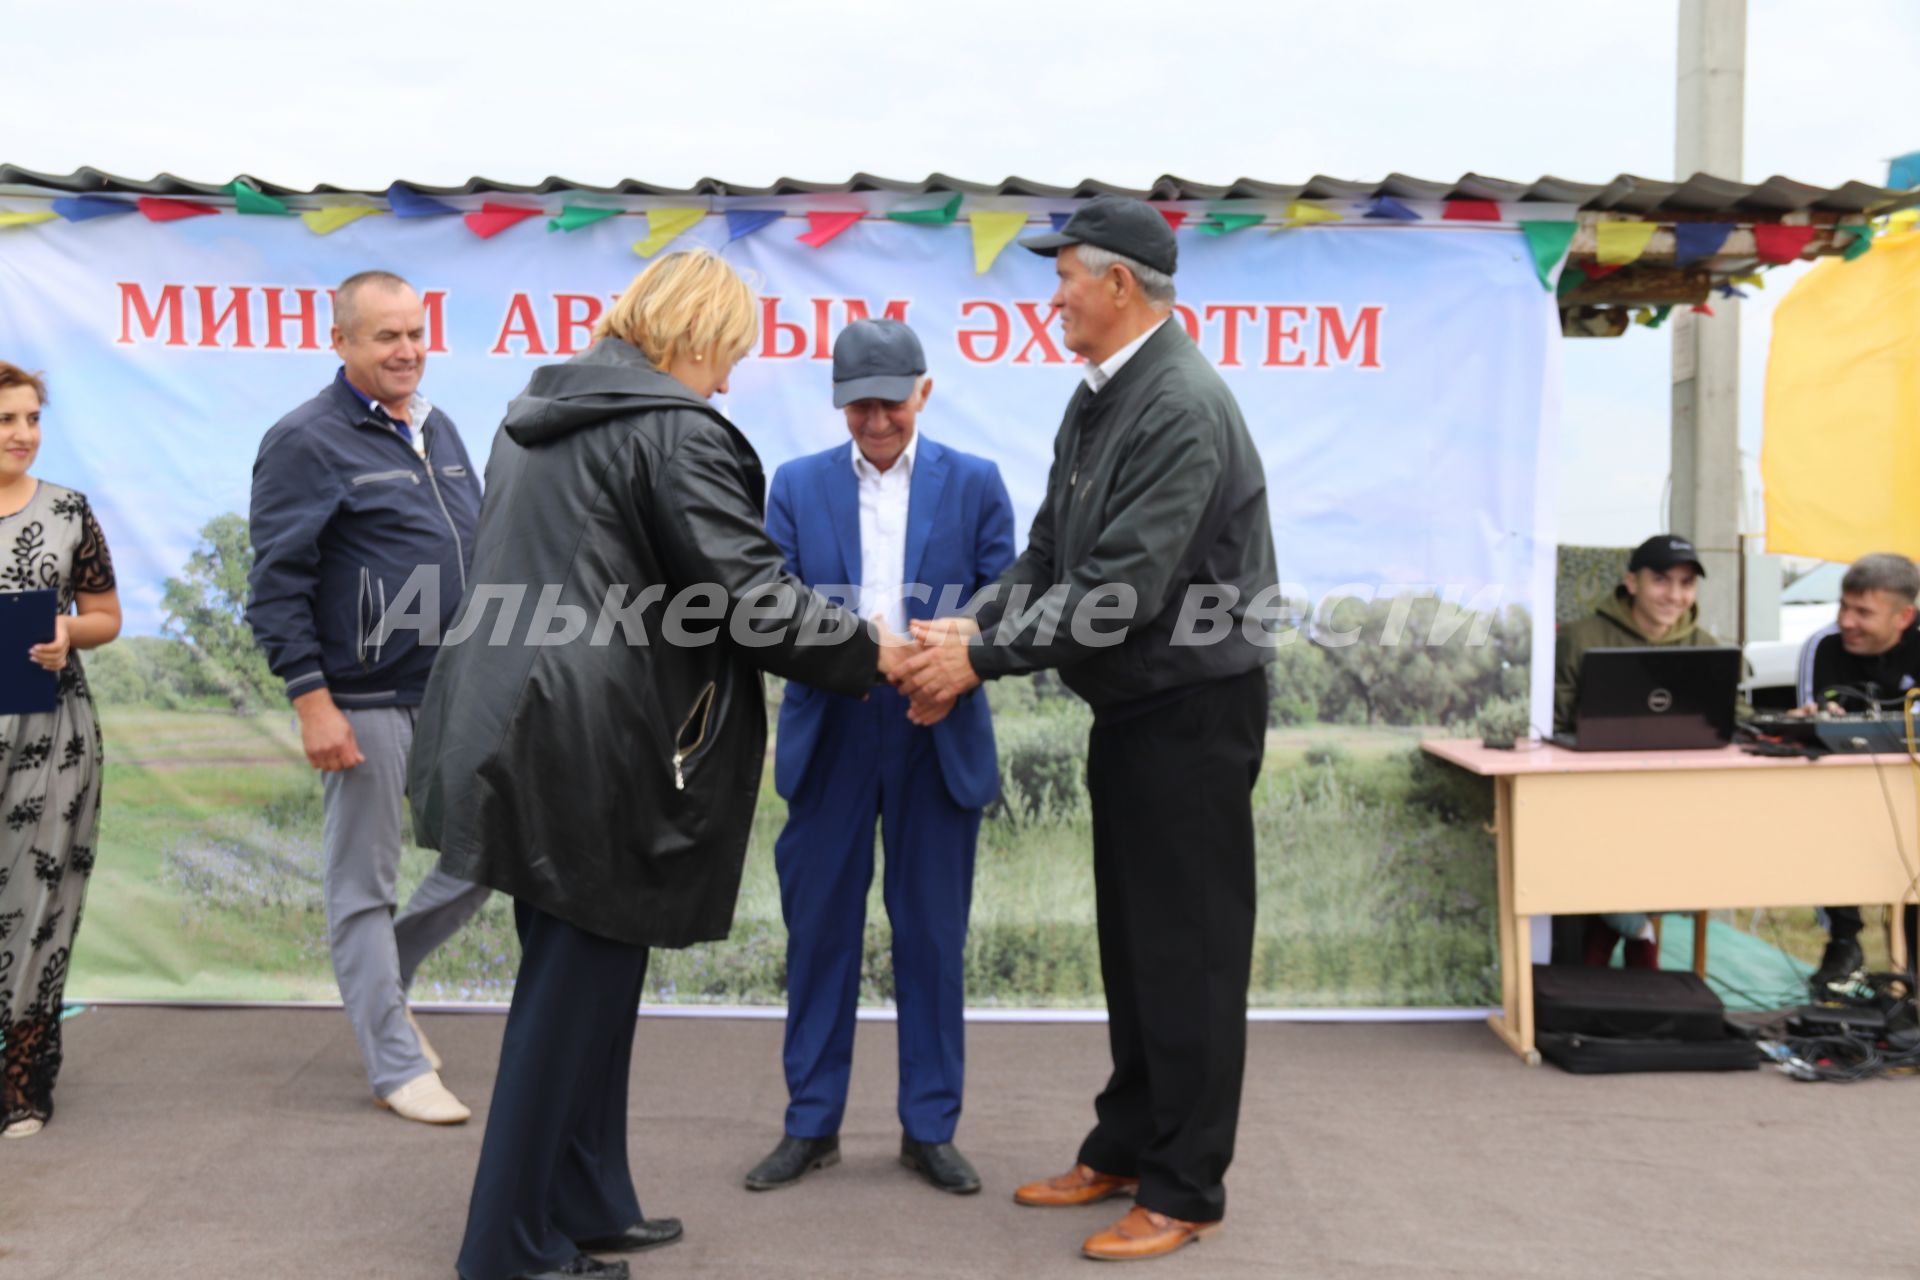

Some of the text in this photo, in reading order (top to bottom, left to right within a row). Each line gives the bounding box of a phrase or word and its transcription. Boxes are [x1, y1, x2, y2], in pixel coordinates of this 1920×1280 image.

[116, 282, 1383, 367] МИН АВЫ ӘХТЕМ
